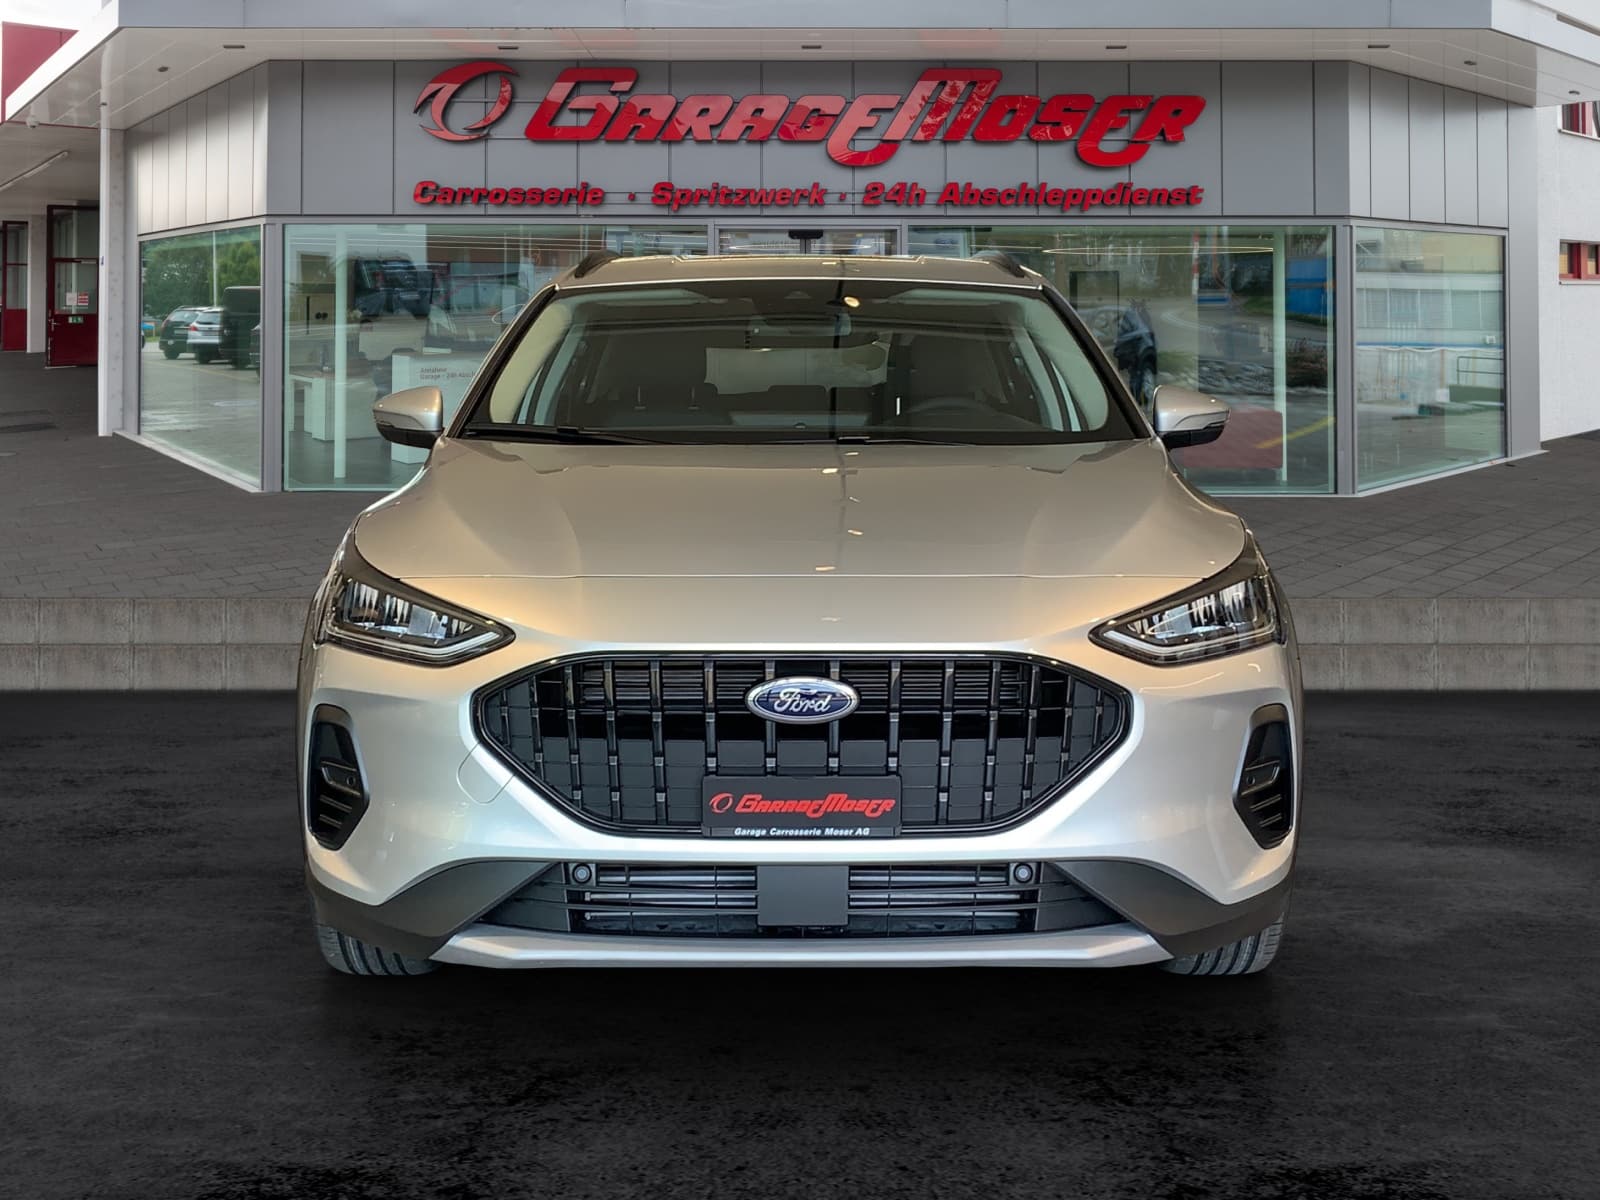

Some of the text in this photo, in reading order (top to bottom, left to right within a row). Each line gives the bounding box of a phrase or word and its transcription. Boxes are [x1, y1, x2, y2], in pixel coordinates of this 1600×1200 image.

[413, 181, 1204, 212] Carrosserie Spritzwerk 24h Abschleppdienst
[774, 688, 832, 712] Ford
[734, 827, 871, 837] Garage Carrosserie Moser AG
